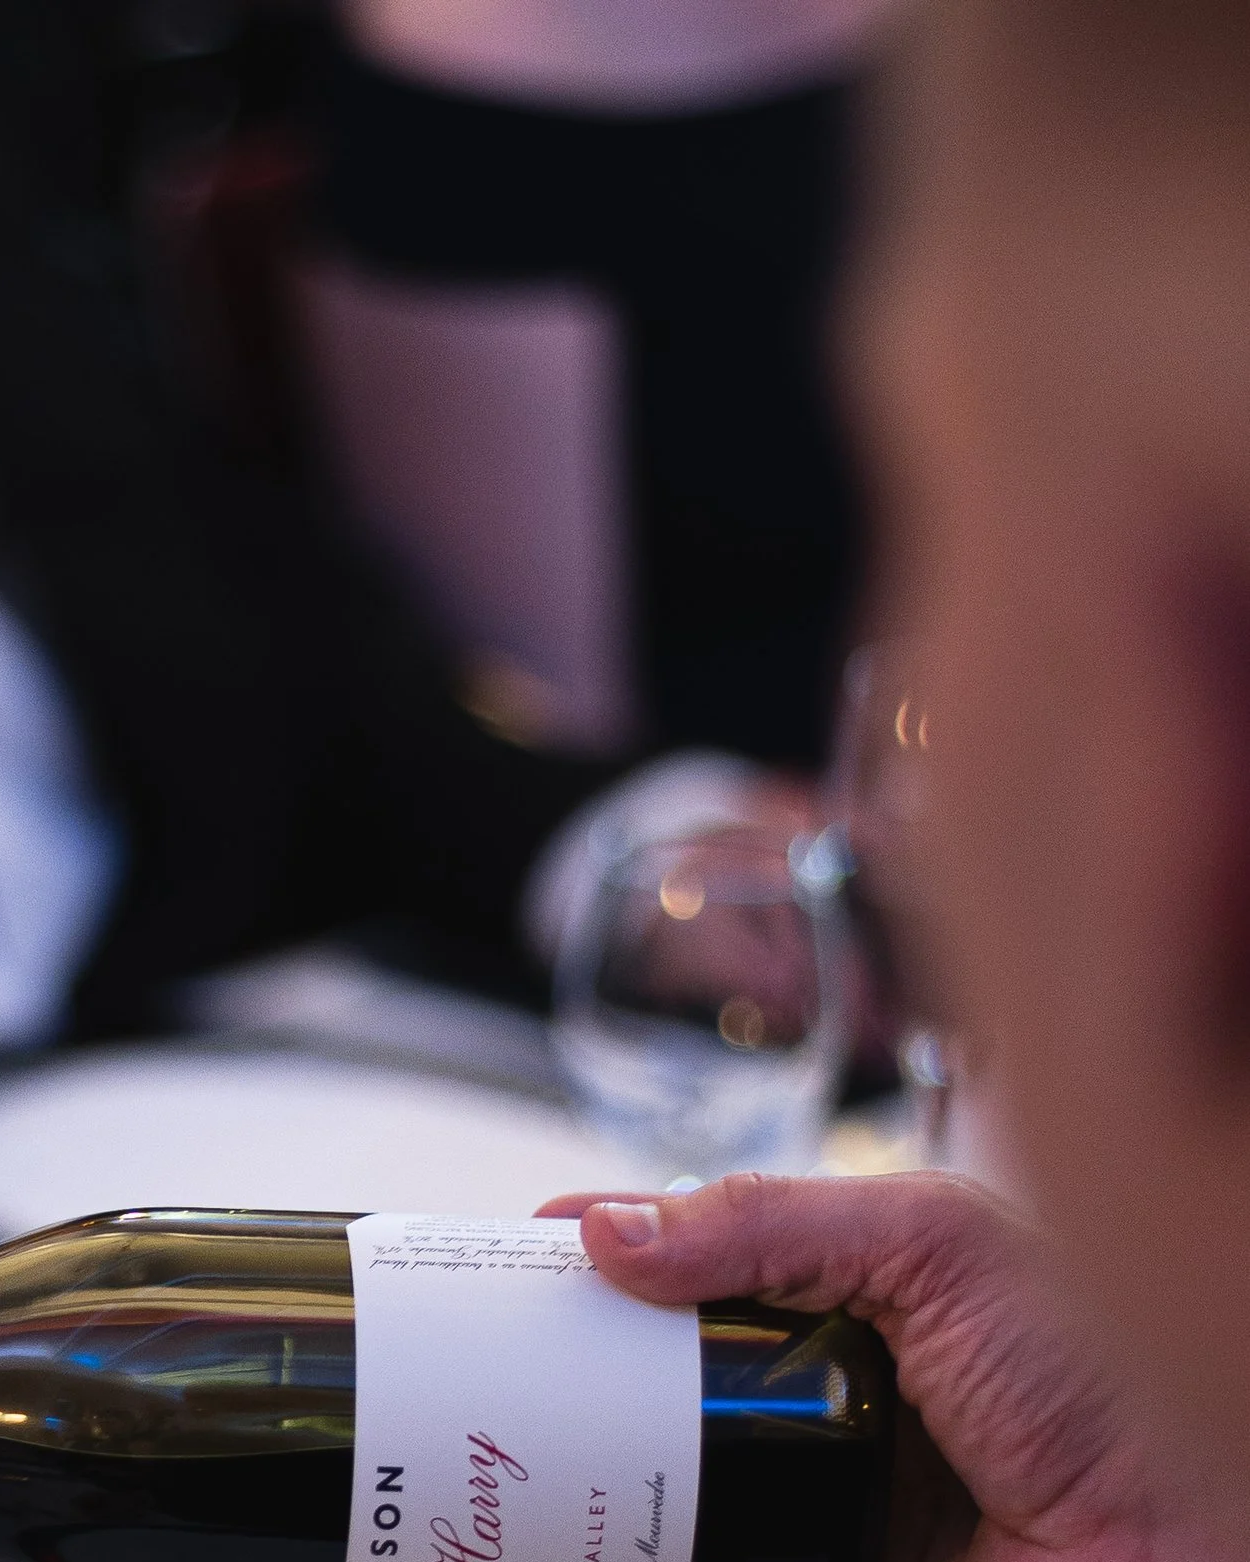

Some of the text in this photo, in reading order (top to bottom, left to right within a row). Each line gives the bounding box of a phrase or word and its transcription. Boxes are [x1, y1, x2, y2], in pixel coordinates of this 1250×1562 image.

[516, 1239, 546, 1247] and
[369, 1259, 410, 1270] blend
[410, 1260, 483, 1272] traditional
[520, 1259, 574, 1275] famous
